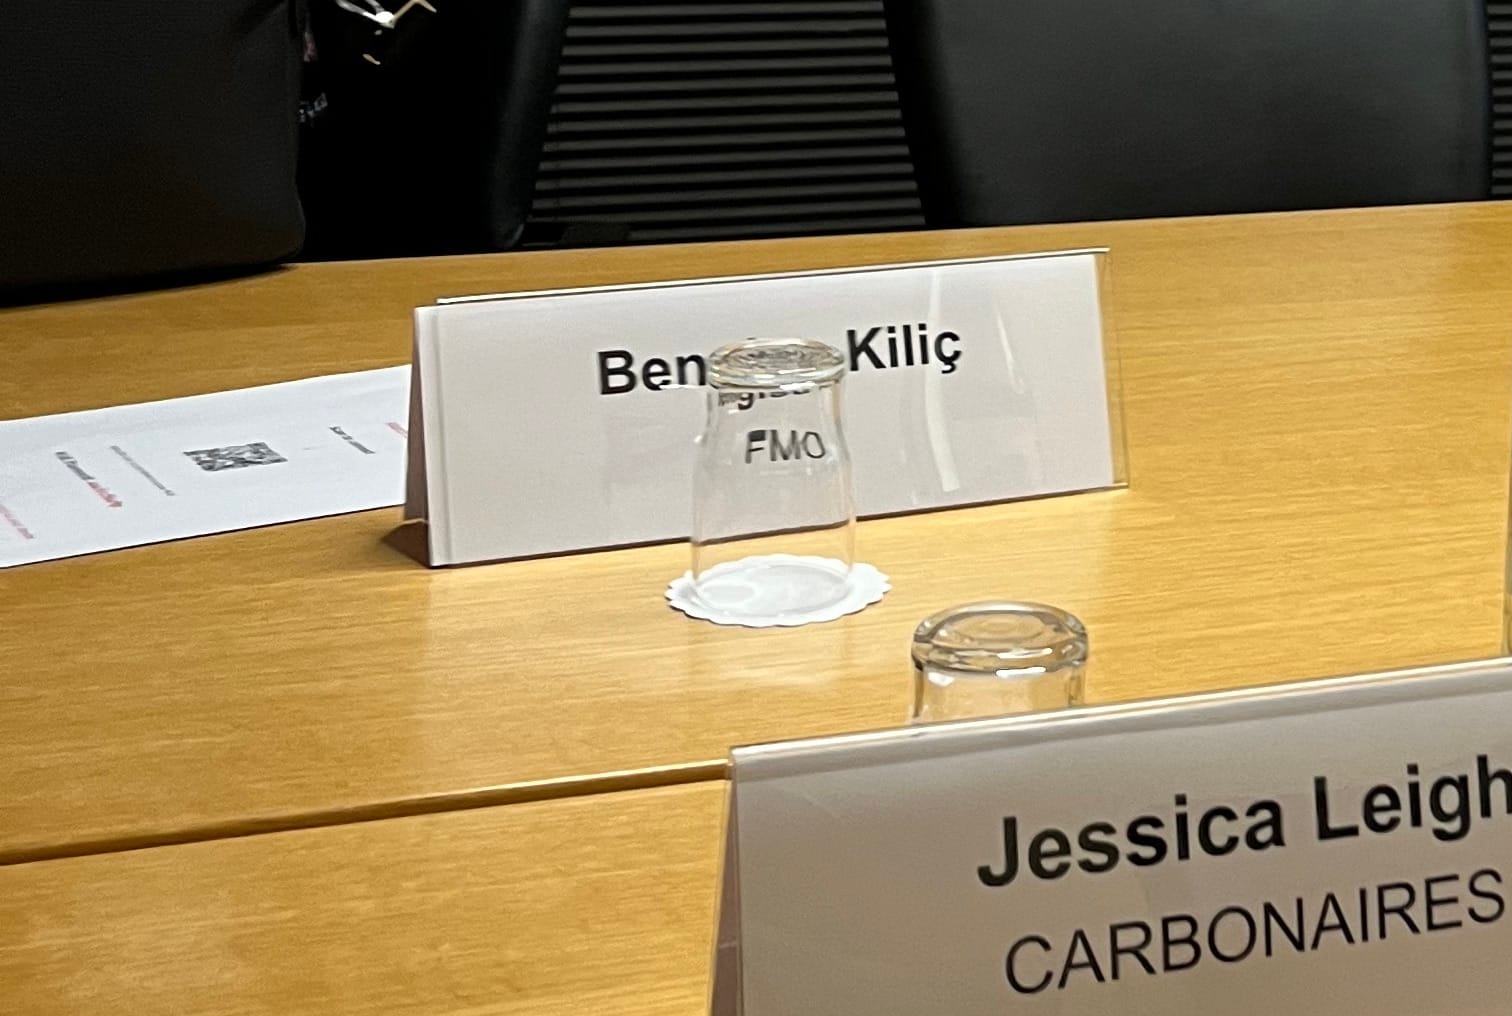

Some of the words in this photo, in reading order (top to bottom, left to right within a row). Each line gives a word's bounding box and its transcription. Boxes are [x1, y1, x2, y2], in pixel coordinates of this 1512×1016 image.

[847, 323, 963, 374] Kiliç
[745, 429, 826, 464] FMO
[976, 794, 1287, 888] Jessica
[1005, 868, 1507, 995] CARBONAIRES
